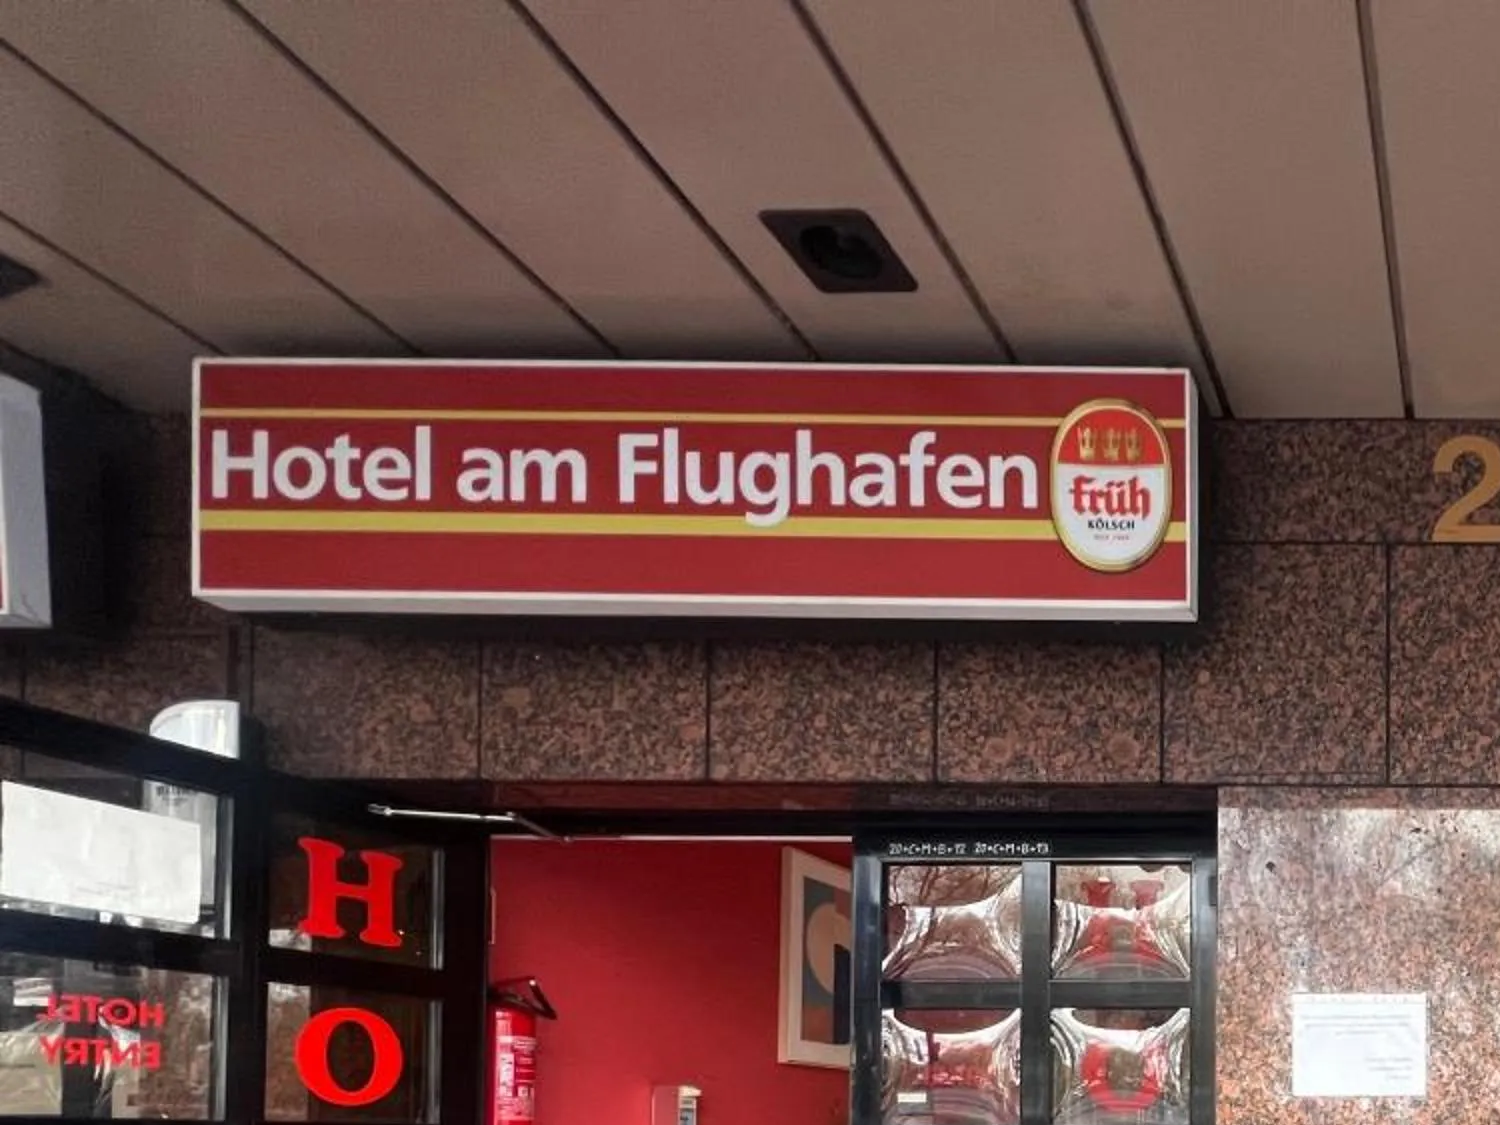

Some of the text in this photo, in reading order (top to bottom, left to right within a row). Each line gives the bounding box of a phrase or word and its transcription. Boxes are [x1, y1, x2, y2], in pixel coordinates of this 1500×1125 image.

[210, 426, 1038, 527] Hotel am Flughafen
[1087, 518, 1135, 531] KÖLSCH
